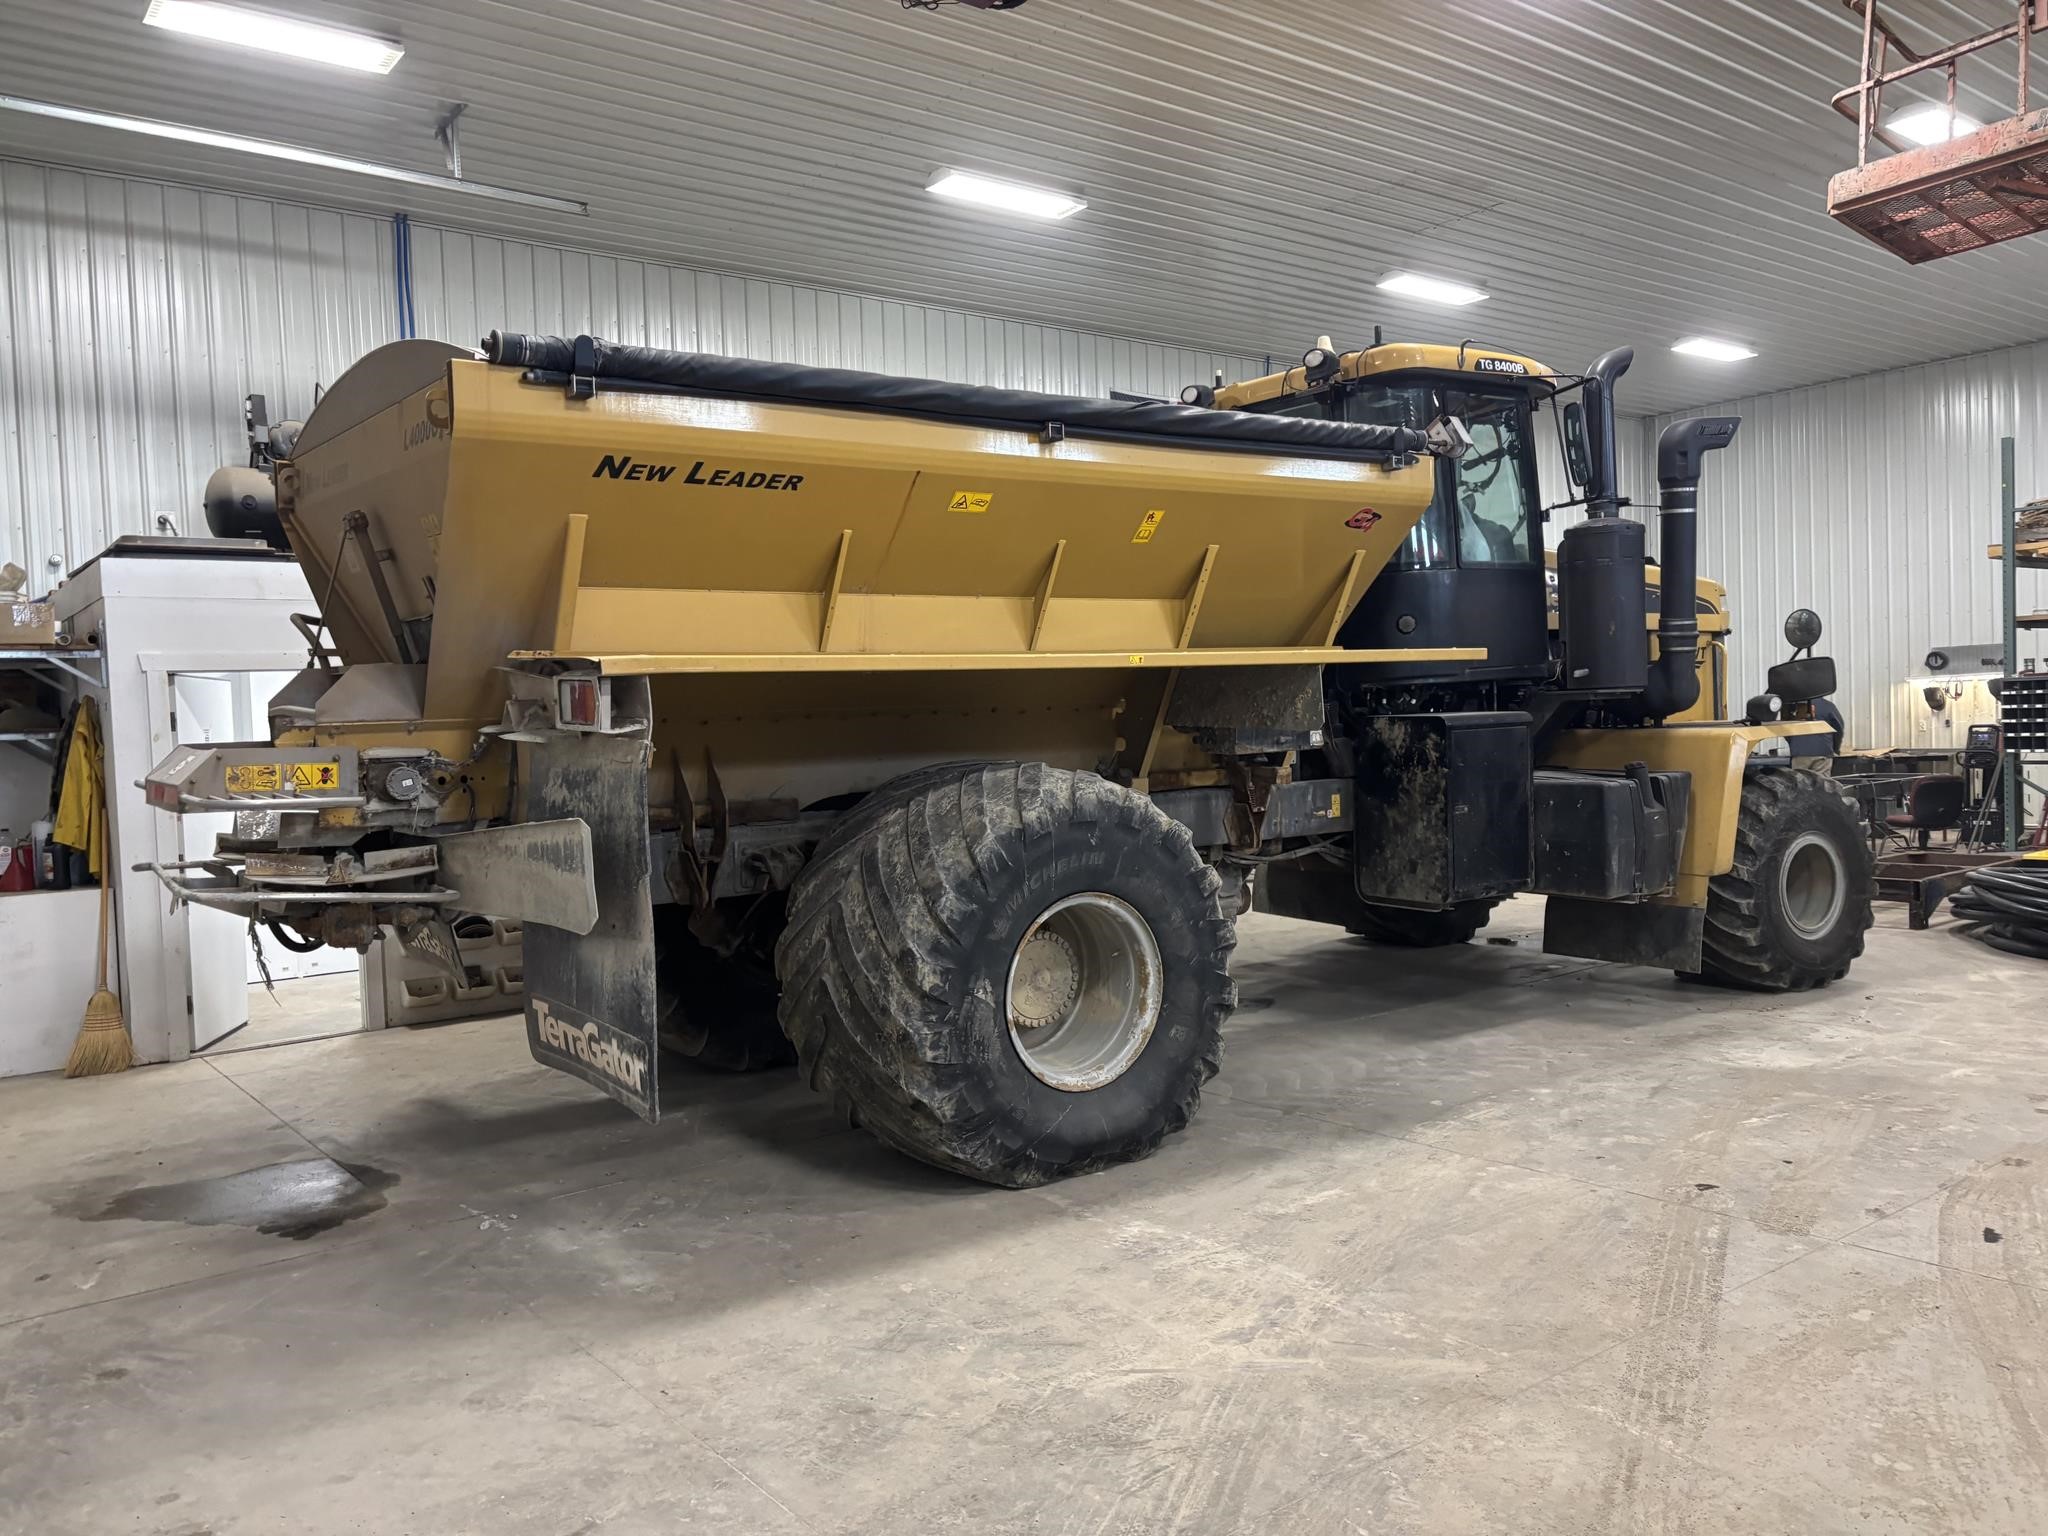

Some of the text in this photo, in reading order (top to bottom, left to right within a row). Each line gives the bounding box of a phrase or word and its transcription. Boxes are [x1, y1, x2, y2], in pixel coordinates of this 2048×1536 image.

[1479, 359, 1525, 374] TG 8400B
[1004, 850, 1106, 916] MICHELIN
[532, 998, 646, 1093] TerraGator
